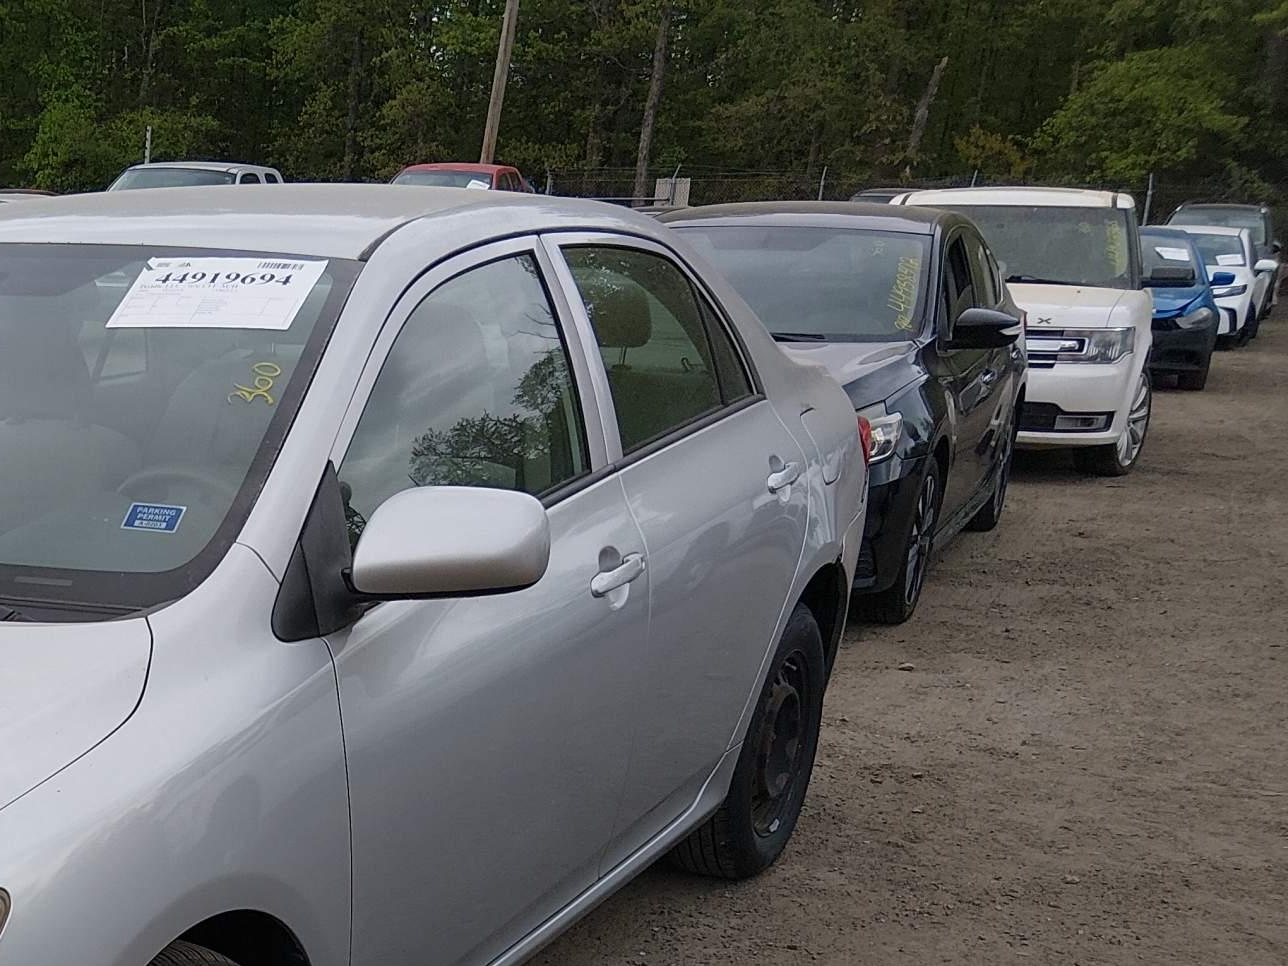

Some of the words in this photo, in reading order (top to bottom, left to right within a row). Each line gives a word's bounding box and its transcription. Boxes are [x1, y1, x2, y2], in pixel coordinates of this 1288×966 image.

[154, 271, 293, 286] 44919694
[137, 507, 176, 515] PARKING
[137, 513, 171, 521] PERMIT
